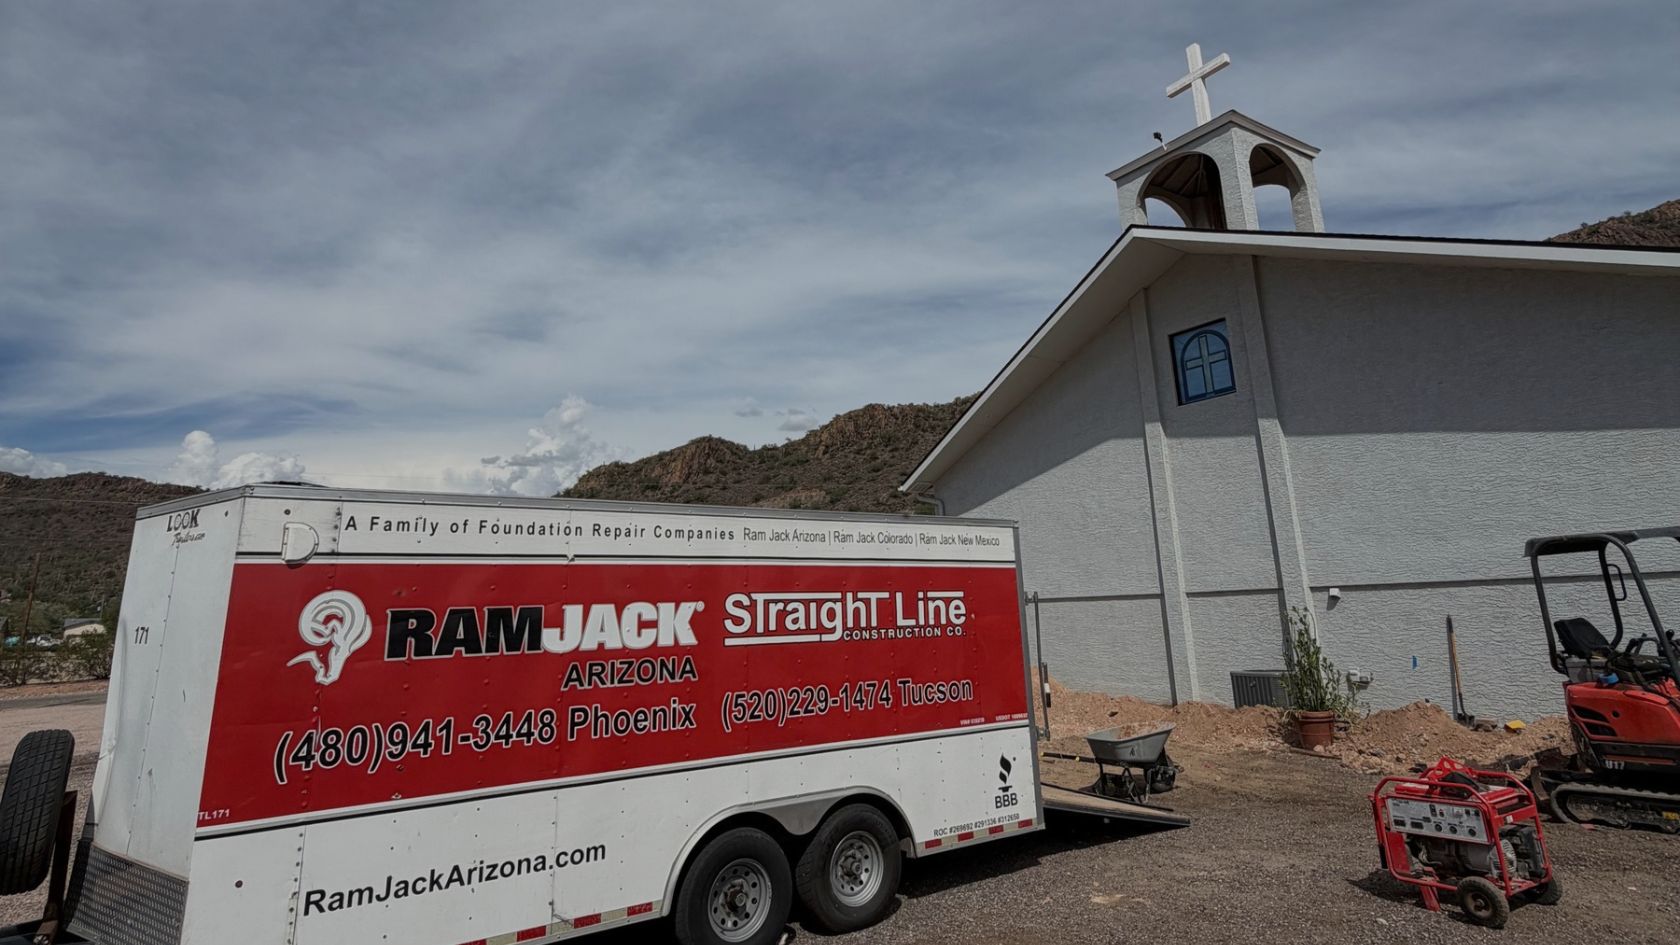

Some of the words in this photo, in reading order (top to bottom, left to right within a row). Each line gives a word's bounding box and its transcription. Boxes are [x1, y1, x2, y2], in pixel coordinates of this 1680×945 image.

[166, 508, 201, 532] LOOK
[344, 516, 357, 531] A
[369, 516, 439, 537] Family
[450, 519, 469, 534] of
[478, 519, 582, 537] Foundation
[592, 523, 646, 540] Repair
[653, 525, 735, 542] Companies
[743, 527, 767, 541] Ram
[768, 528, 791, 542] Jack
[791, 528, 827, 544] Arizona
[833, 530, 854, 543] Ram
[856, 531, 876, 544] Jack
[877, 531, 914, 545] Colorado
[919, 533, 937, 545] Ram
[938, 533, 956, 546] Jack
[957, 534, 974, 546] New
[975, 534, 1000, 547] Mexico
[895, 591, 968, 628] Line
[134, 626, 150, 645] 171
[842, 626, 942, 641] CONSTRUCTION
[946, 625, 967, 637] CO.
[560, 655, 699, 691] ARIZONA
[721, 680, 892, 733] (520)229-1474
[897, 678, 974, 706] Tucson
[273, 708, 558, 784] (480)941-3448
[567, 697, 697, 741] Phoenix
[198, 808, 230, 820] TL171
[994, 793, 1019, 809] BBB
[933, 828, 948, 837] ROC
[303, 844, 606, 917] RamJackArizona.com
